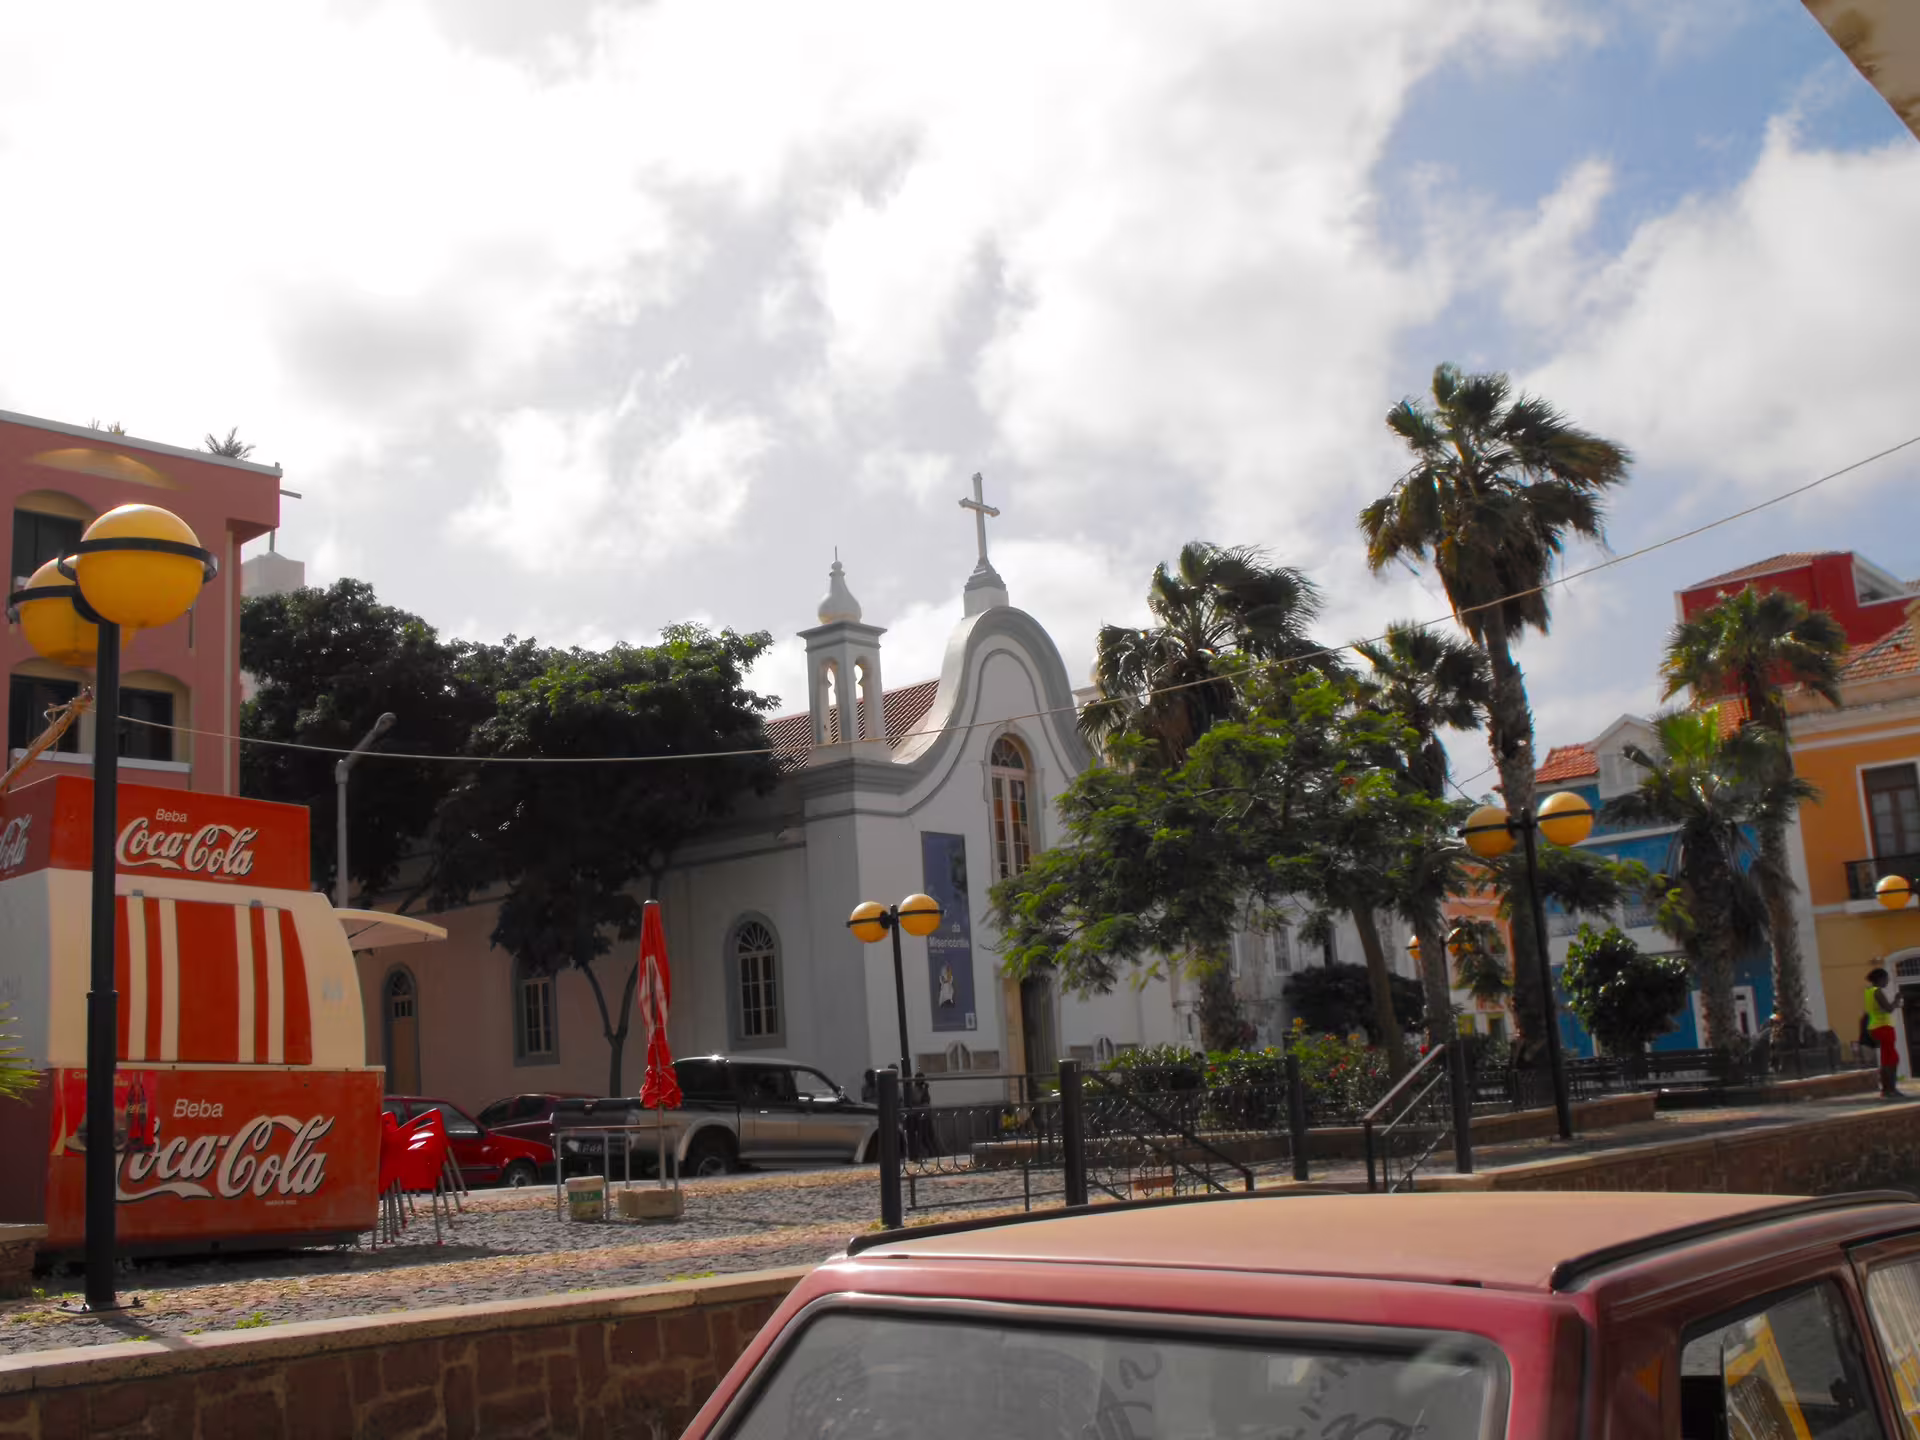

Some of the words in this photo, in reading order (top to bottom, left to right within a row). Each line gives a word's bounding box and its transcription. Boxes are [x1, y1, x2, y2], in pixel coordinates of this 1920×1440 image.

[155, 808, 188, 823] Beba
[115, 816, 259, 875] Coca-Cola
[173, 1098, 225, 1118] Beba
